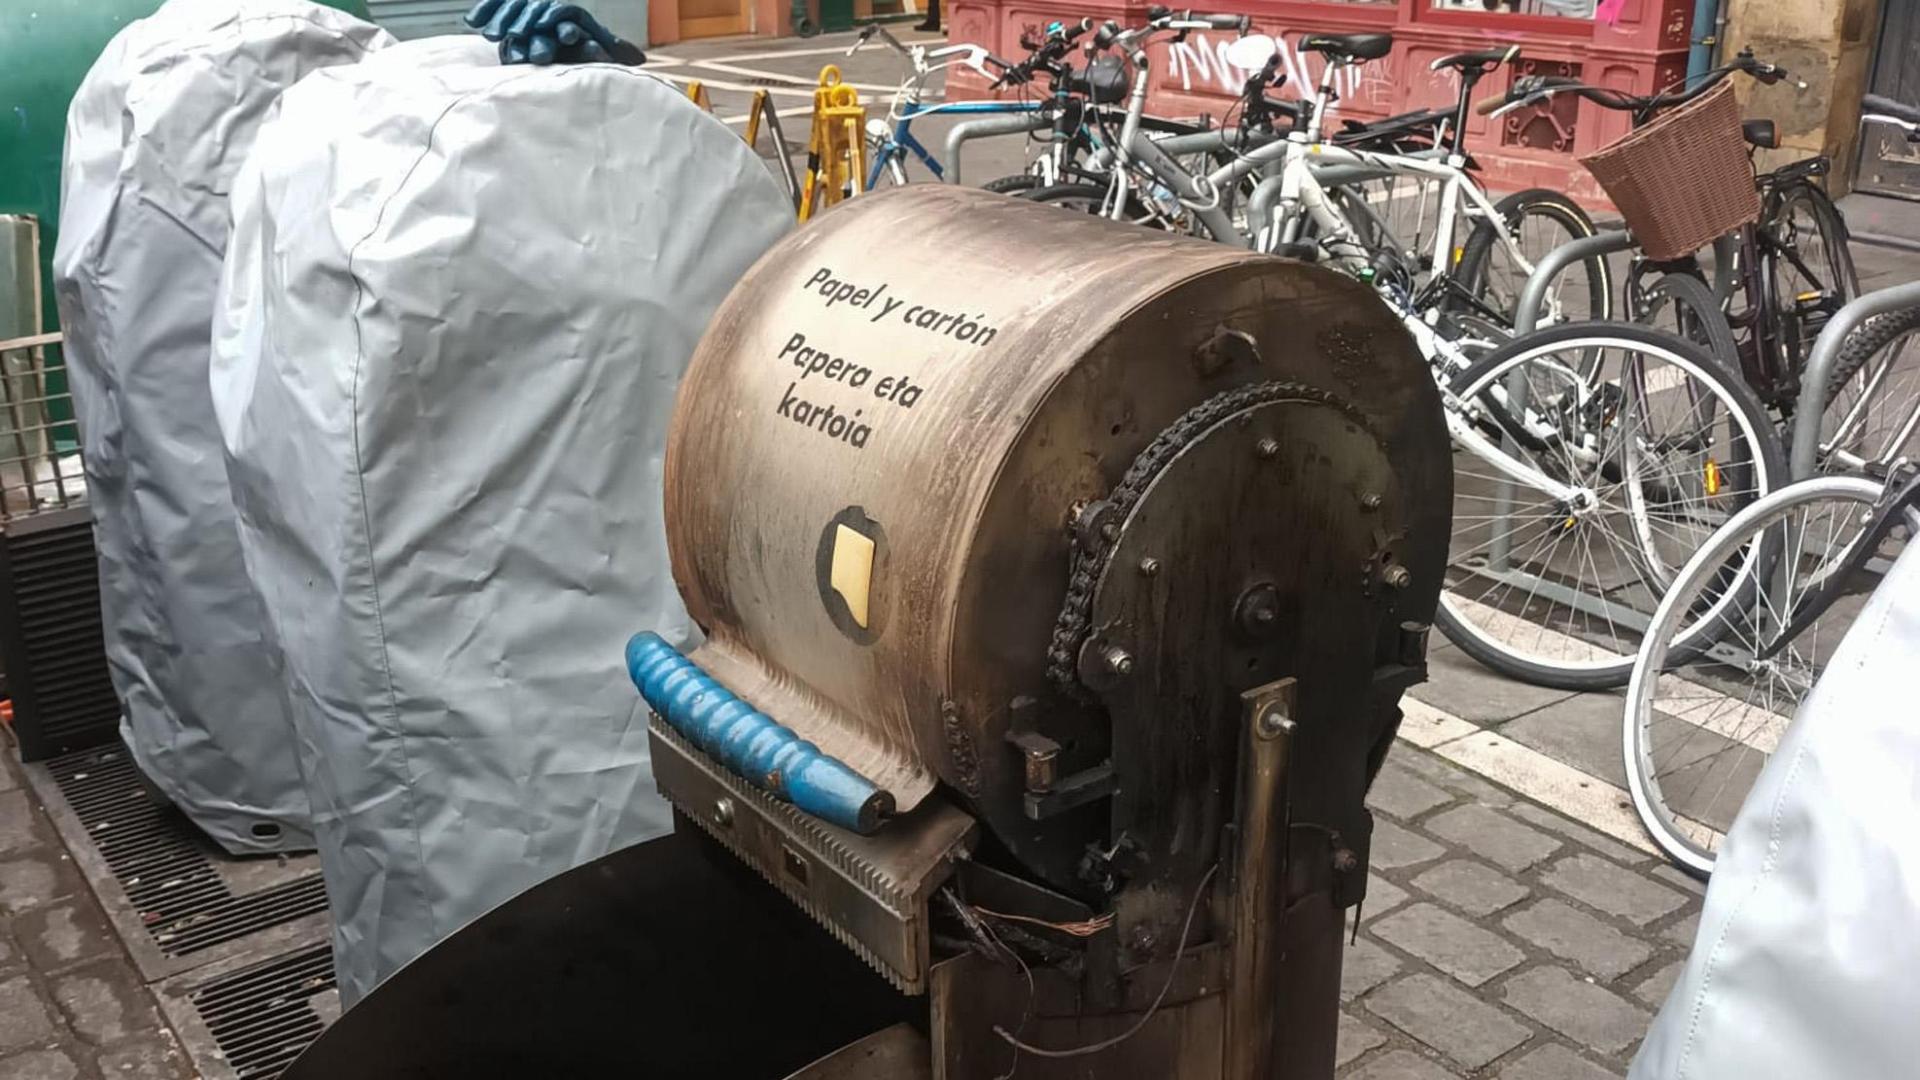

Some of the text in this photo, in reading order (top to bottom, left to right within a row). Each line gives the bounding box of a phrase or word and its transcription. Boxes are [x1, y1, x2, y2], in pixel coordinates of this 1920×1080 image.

[804, 267, 997, 346] Papel y cartón
[778, 333, 924, 408] Papera eta
[777, 382, 872, 449] kartoia
